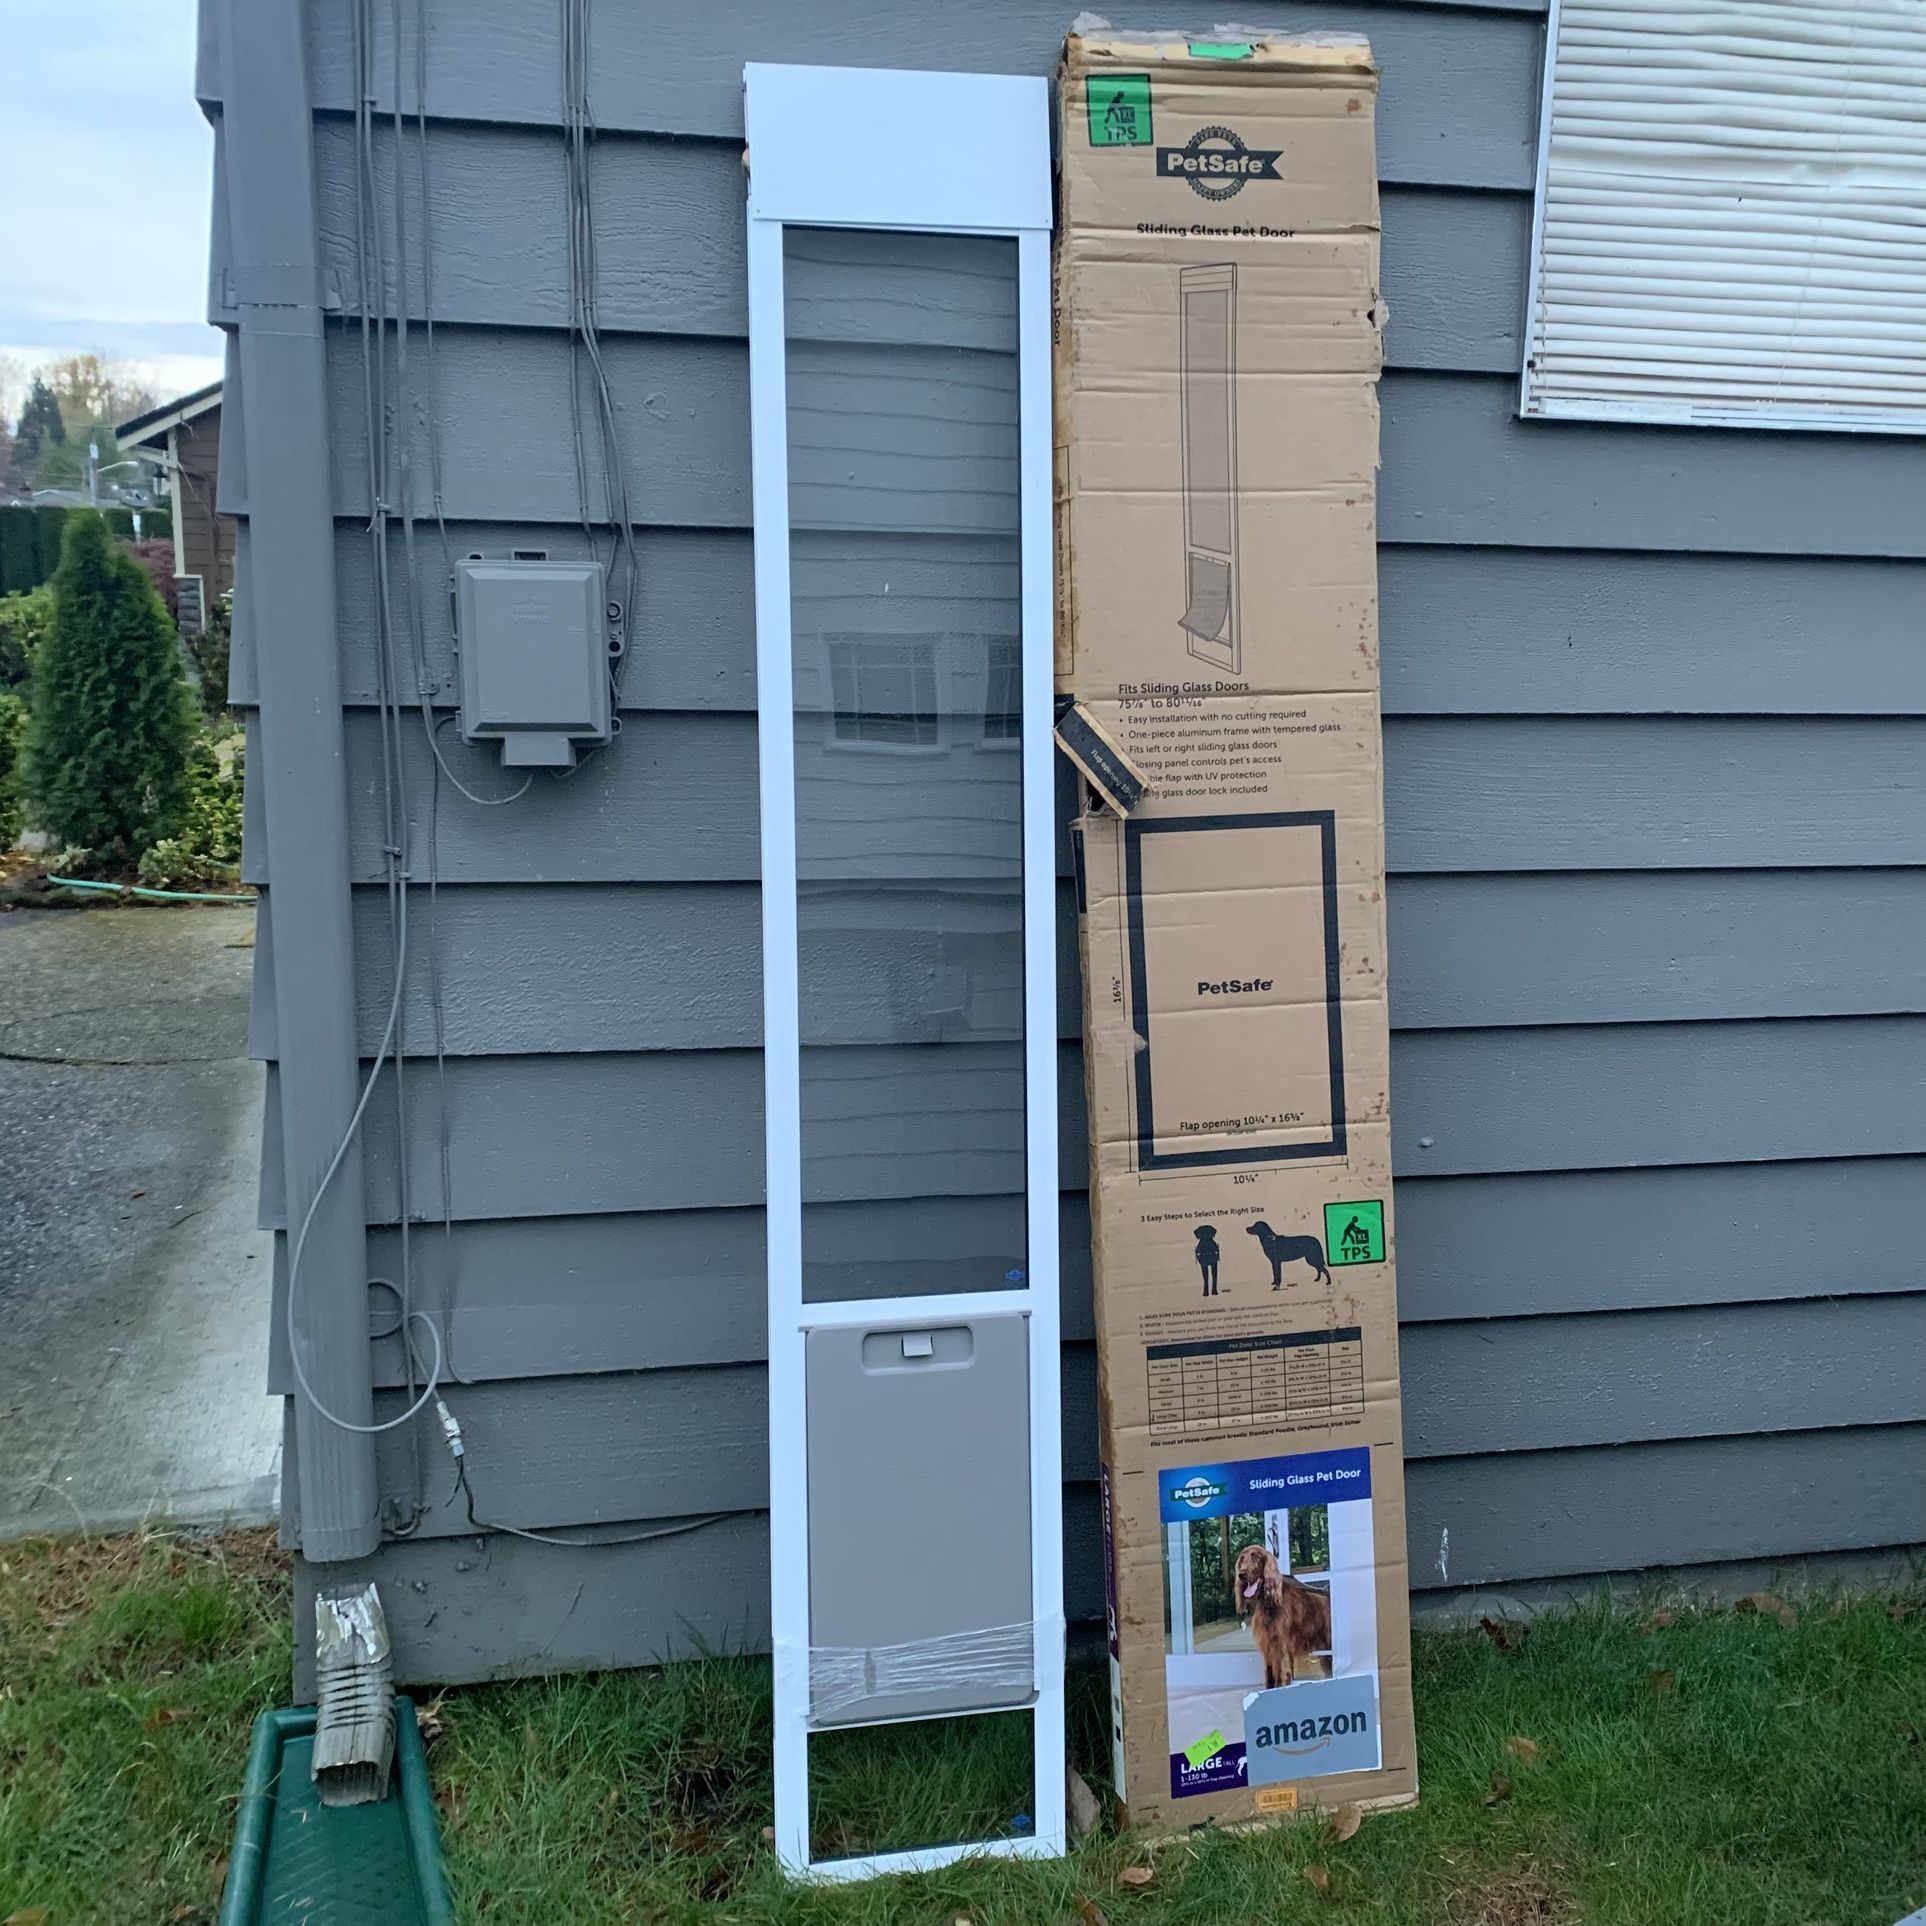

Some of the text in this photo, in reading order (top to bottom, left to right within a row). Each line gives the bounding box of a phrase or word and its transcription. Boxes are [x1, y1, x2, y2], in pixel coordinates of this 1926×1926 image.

[1167, 152, 1263, 173] PetSafe
[1136, 222, 1296, 238] Sliding Glass Pet Door
[1118, 681, 1249, 695] Fits Sliding Glass Doors
[1151, 698, 1163, 709] to
[1128, 715, 1147, 725] Easy
[1149, 713, 1198, 723] installation
[1199, 713, 1219, 722] with
[1235, 711, 1267, 721] cutting
[1269, 709, 1307, 720] required
[1128, 723, 1341, 740] One-piece aluminum frame with tempered glass
[1129, 741, 1278, 754] Fits left or right sliding glass doors
[1091, 749, 1103, 763] Flap
[1133, 755, 1282, 769] losing panel controls pet's access
[1165, 774, 1182, 783] flap
[1184, 772, 1203, 781] with
[1205, 772, 1219, 781] UV
[1220, 770, 1267, 781] protection
[1162, 787, 1184, 798] glass
[1186, 787, 1207, 796] door
[1209, 785, 1227, 795] lock
[1229, 784, 1268, 794] included
[1197, 978, 1274, 996] PetSafe
[1180, 1121, 1200, 1131] Flap
[1202, 1118, 1241, 1131] opening
[1146, 1214, 1162, 1223] Easy
[1163, 1212, 1183, 1221] Steps
[1194, 1210, 1216, 1218] Select
[1216, 1209, 1228, 1217] the
[1230, 1207, 1249, 1217] Right
[1250, 1206, 1265, 1214] Size
[1356, 1233, 1367, 1241] XL
[1340, 1245, 1371, 1261] TPS
[1249, 1468, 1361, 1491] Sliding Glass Pet Door
[1174, 1486, 1220, 1499] PetSafe
[1255, 1711, 1367, 1748] amazon
[1180, 1773, 1200, 1783] 1-130
